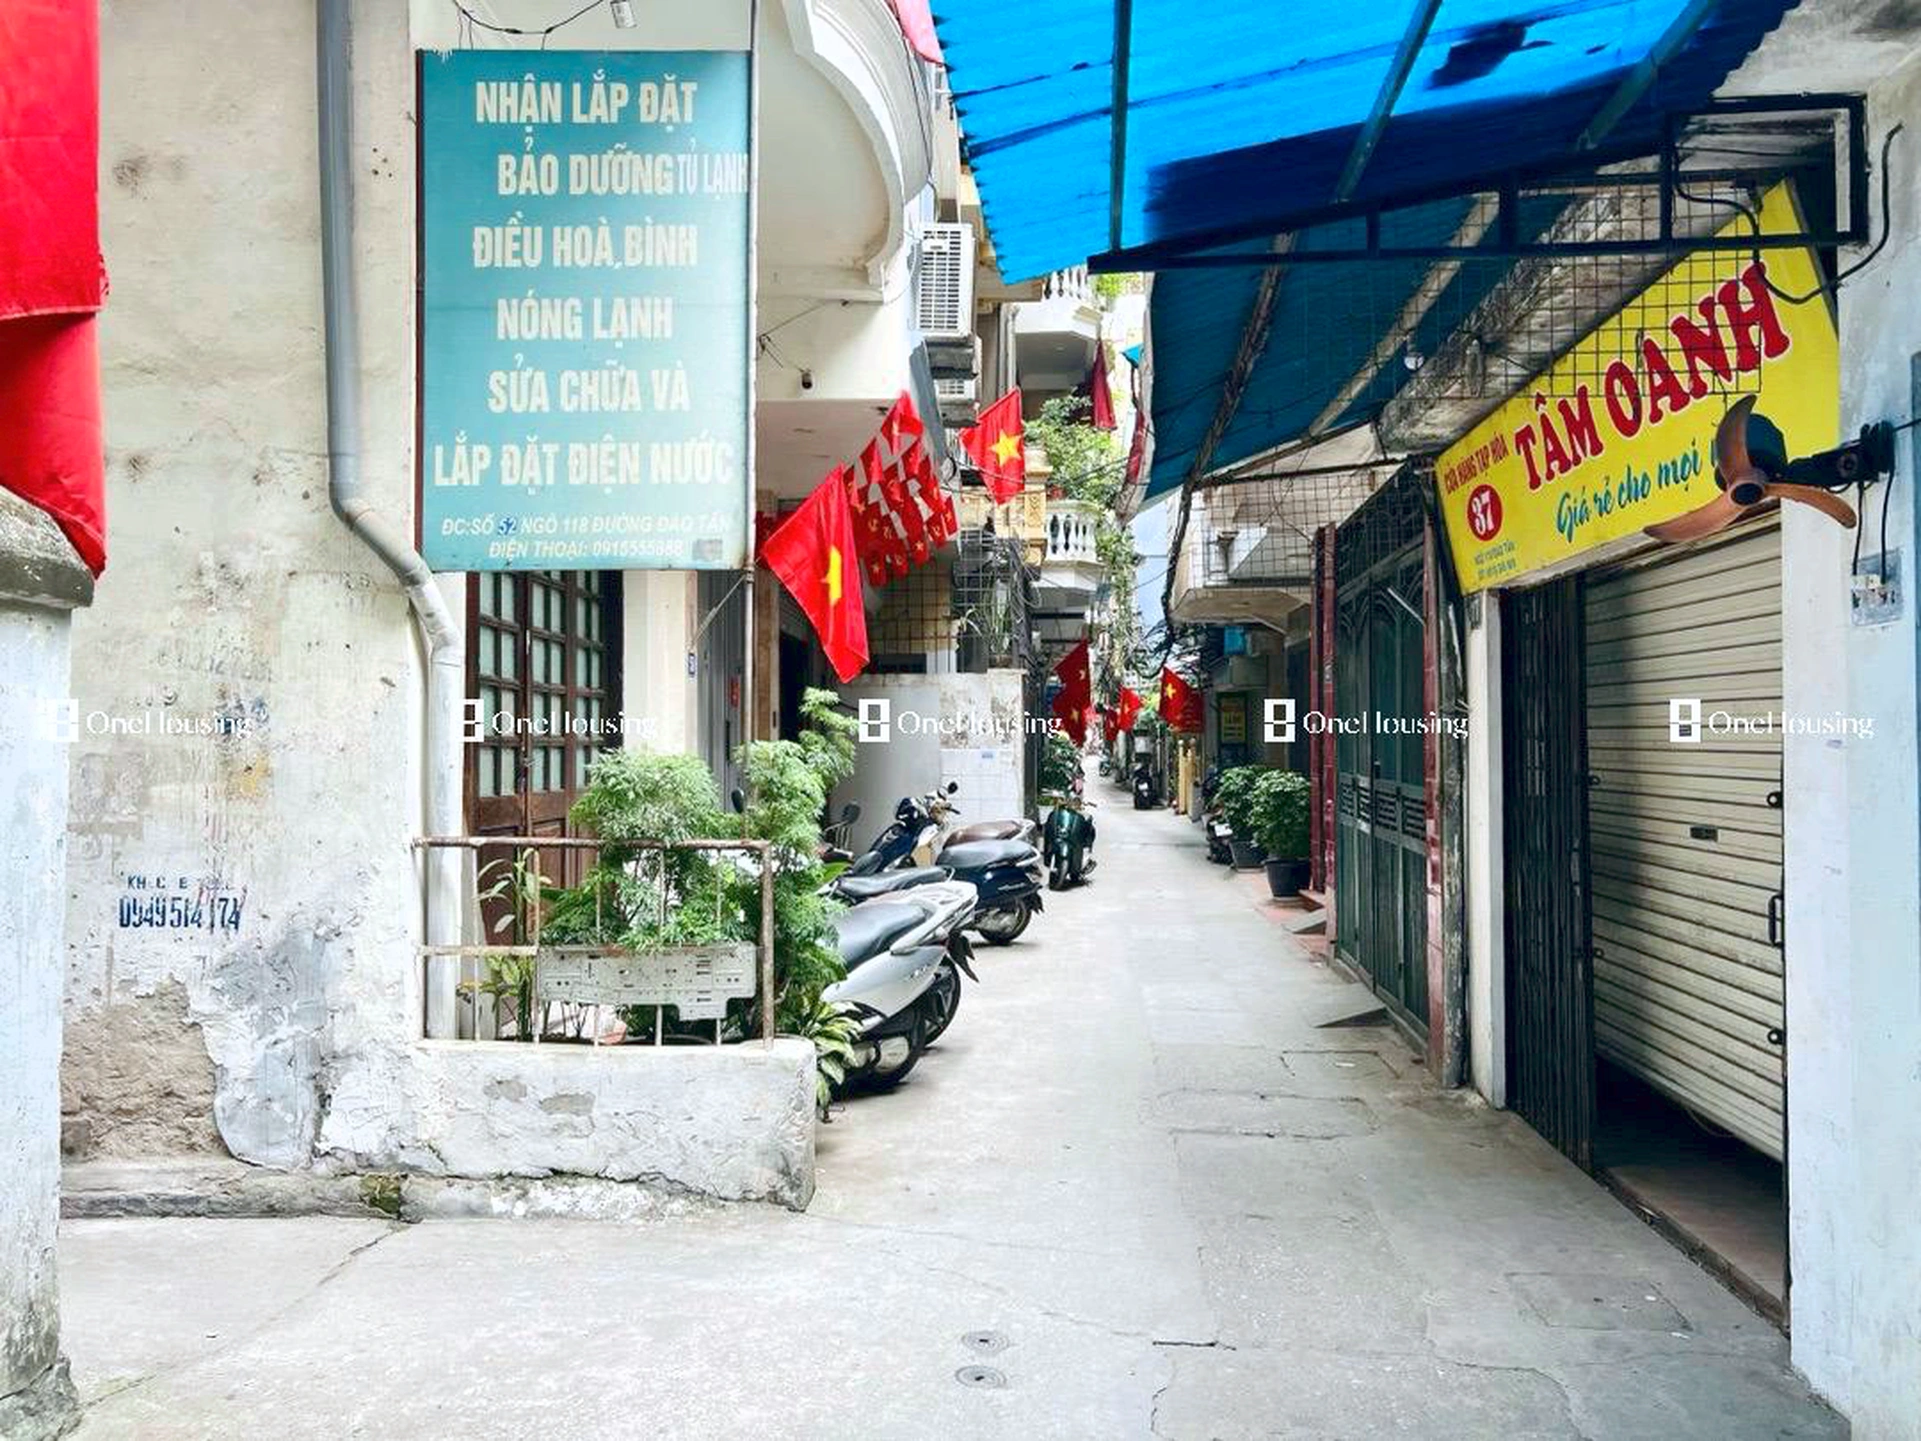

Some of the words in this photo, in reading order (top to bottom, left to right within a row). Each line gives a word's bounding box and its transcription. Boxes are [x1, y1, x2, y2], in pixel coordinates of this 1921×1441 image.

[475, 72, 562, 133] NHẬN
[572, 68, 629, 124] LẮP
[638, 73, 698, 133] ĐẶT
[498, 136, 560, 196] BẢO
[568, 142, 673, 196] DƯỠNG
[473, 210, 543, 268] ĐIỀU
[624, 217, 699, 268] BÌNH
[497, 289, 583, 340] NÓNG
[593, 297, 673, 348] LẠNH
[487, 353, 550, 414] SỬA
[559, 360, 642, 413] CHỮA
[650, 360, 691, 412] VÀ
[1514, 391, 1605, 491] TÂM
[1604, 261, 1791, 438] OANH
[434, 430, 491, 487] LẮP
[501, 435, 561, 496] ĐẶT
[568, 434, 641, 494] ĐIỆN
[650, 429, 735, 485] NƯỚC
[1556, 485, 1591, 544] Giá
[1617, 463, 1651, 510] cho
[1657, 437, 1701, 492] mọi
